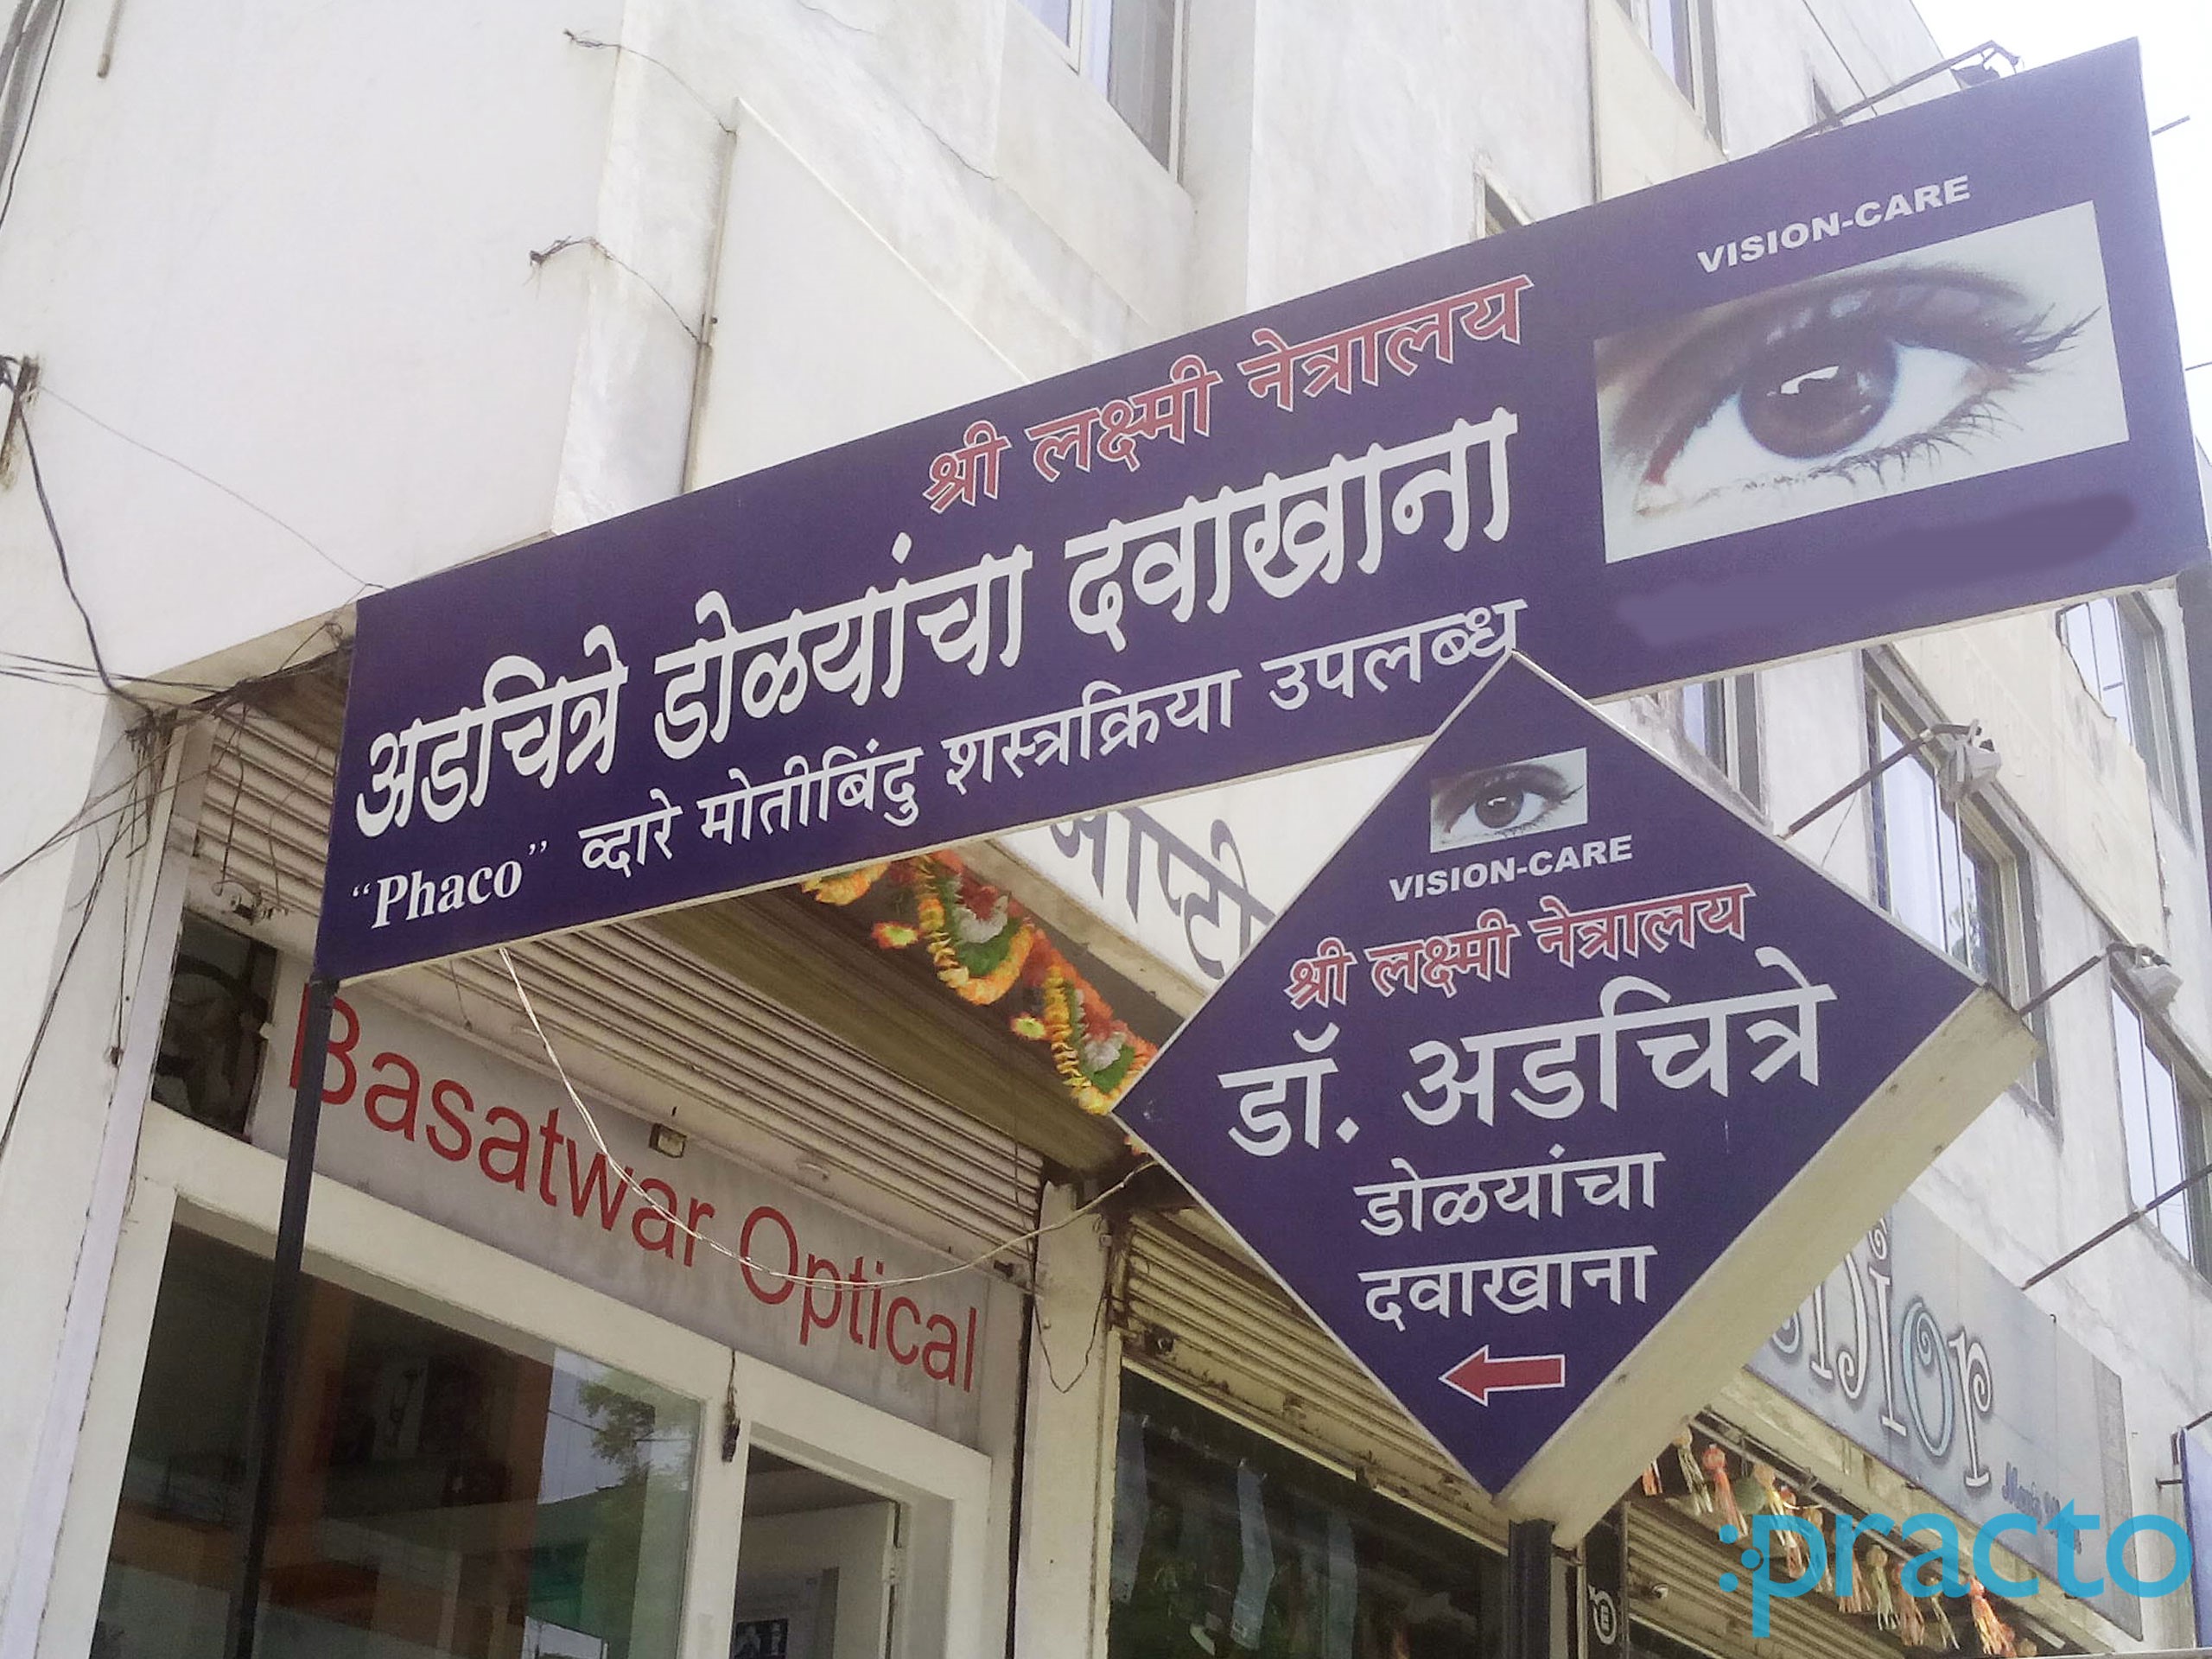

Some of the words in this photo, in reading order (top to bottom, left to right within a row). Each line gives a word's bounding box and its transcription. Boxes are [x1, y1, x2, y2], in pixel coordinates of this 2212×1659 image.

[1697, 175, 1971, 273] VISION-CARE
[923, 420, 1013, 513] श्री
[1025, 354, 1223, 482] लक्ष्मी
[1238, 274, 1535, 411] नेत्रालय
[355, 624, 629, 838] अडचित्रे
[1064, 406, 1518, 652] दवाखाना
[696, 738, 925, 845] मोतीबिंदु
[940, 669, 1243, 795] शस्त्रक्रिया
[1261, 599, 1528, 710] उपलब्ध
[1284, 937, 1358, 1010] श्री
[1363, 908, 1522, 998] लक्ष्मी
[1528, 882, 1757, 969] नेत्रालय
[1389, 835, 1633, 902] VISION-CARE
[1218, 1022, 1360, 1155] डॉ.
[1402, 946, 1838, 1127] अडचित्रे
[289, 983, 715, 1268] Basatwar
[740, 1206, 978, 1392] Optical
[1357, 1245, 1658, 1332] दवाखाना
